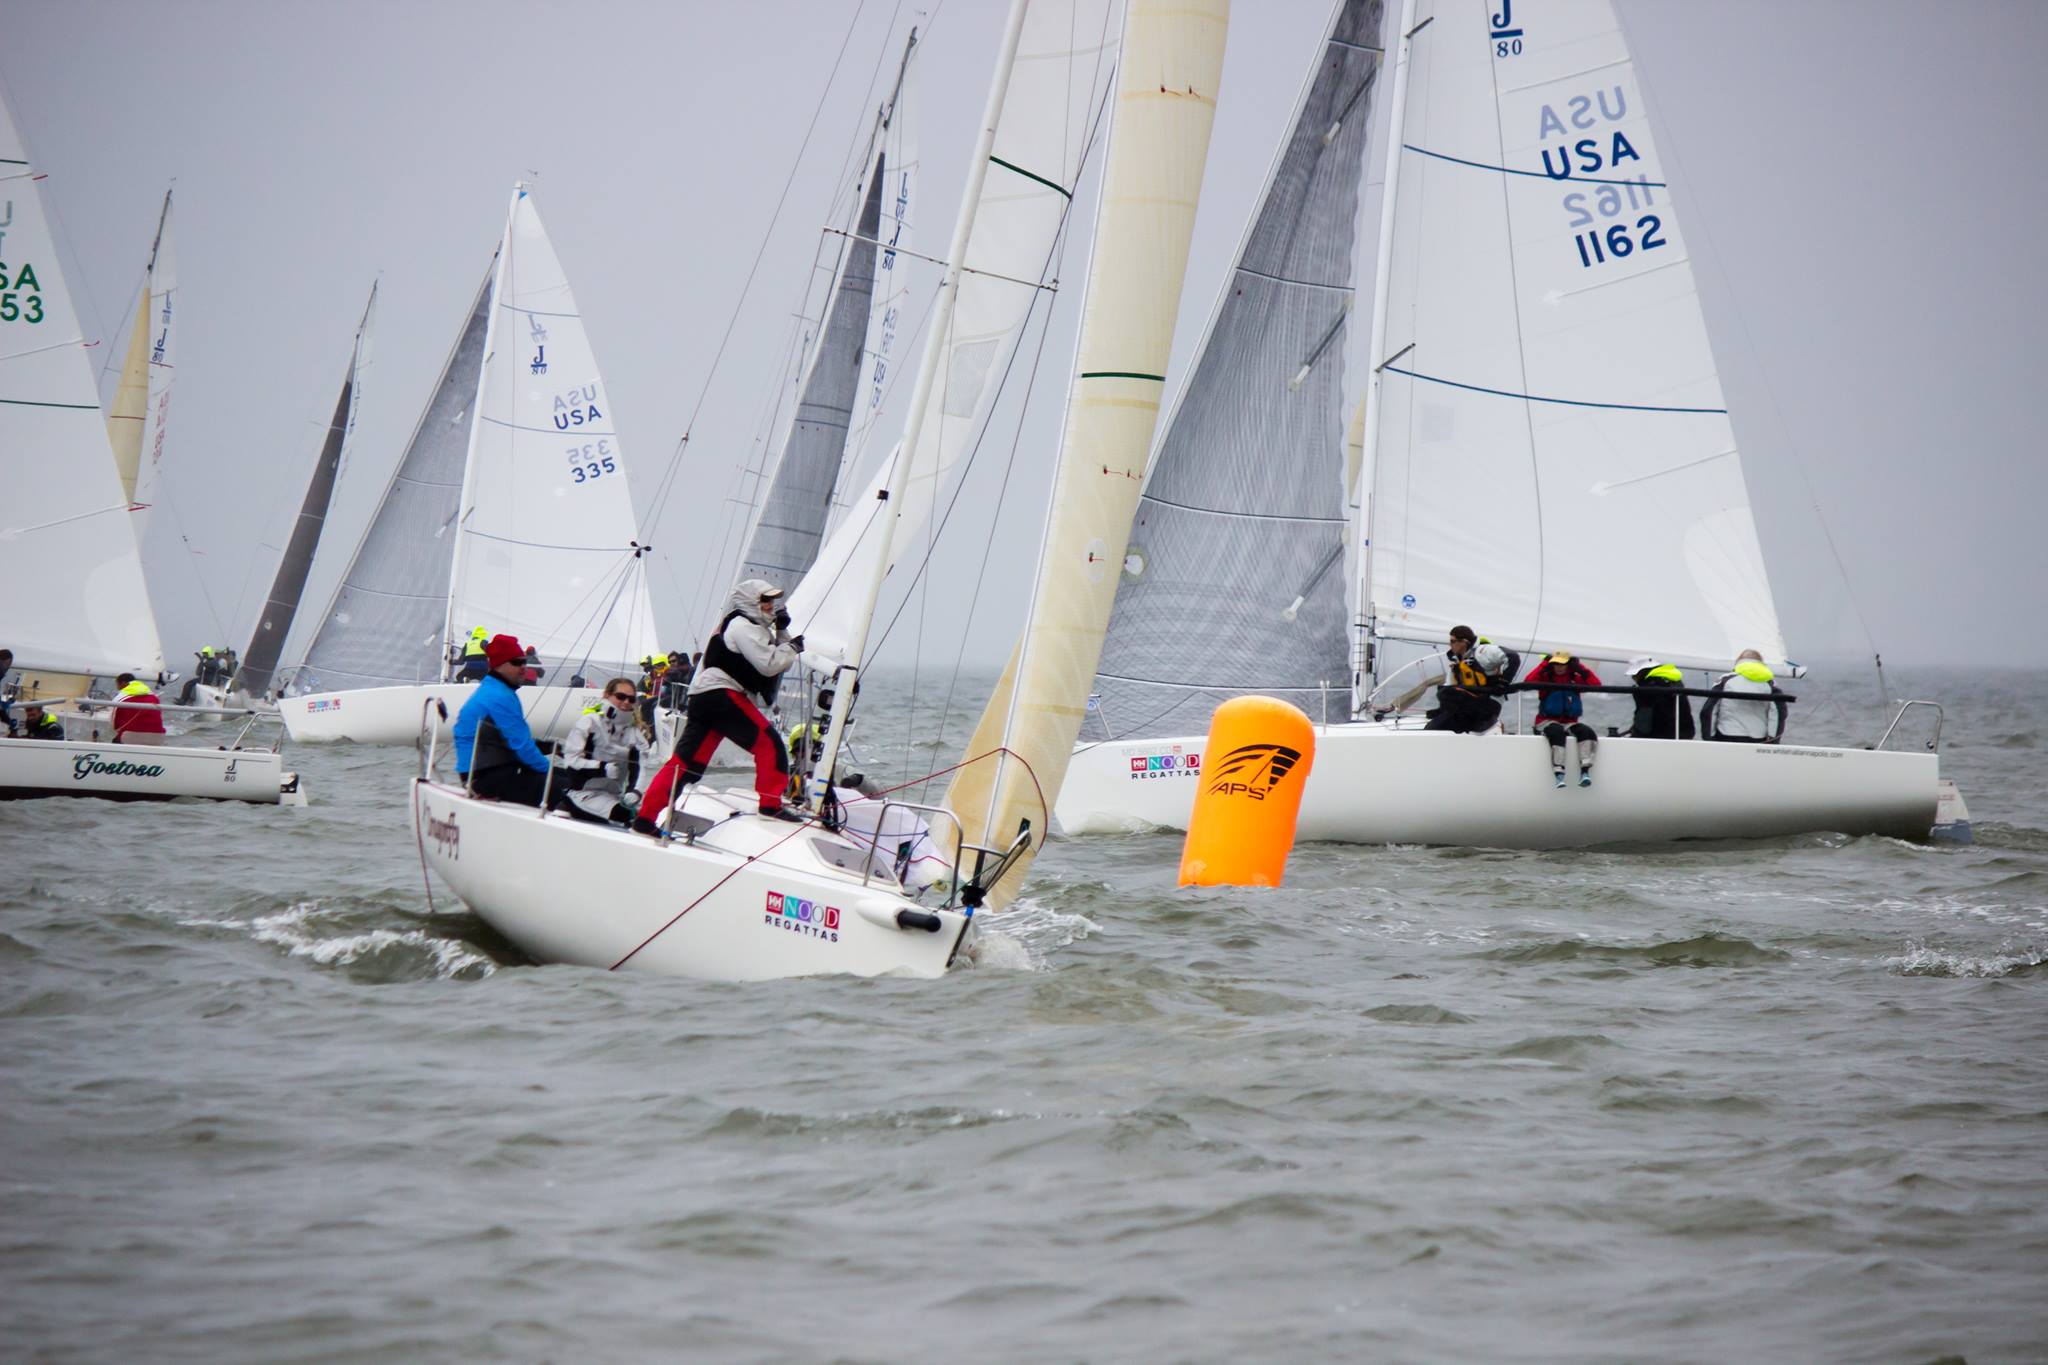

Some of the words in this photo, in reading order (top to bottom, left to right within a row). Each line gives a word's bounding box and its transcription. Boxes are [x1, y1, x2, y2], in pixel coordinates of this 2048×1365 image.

[1492, 0, 1511, 29] J
[1497, 39, 1522, 58] 80
[1541, 131, 1640, 180] USA
[1575, 214, 1667, 267] 1162
[0, 292, 44, 324] 53
[532, 345, 544, 364] J
[554, 404, 603, 430] USA
[571, 456, 616, 483] 335
[73, 753, 165, 780] Gostosa
[226, 758, 237, 771] J
[1131, 769, 1201, 780] REGATTAS
[1149, 755, 1199, 770] NOOD
[224, 774, 236, 783] 80
[1211, 782, 1266, 801] APS
[785, 897, 839, 928] NOOD
[764, 914, 839, 943] REGATTAS
